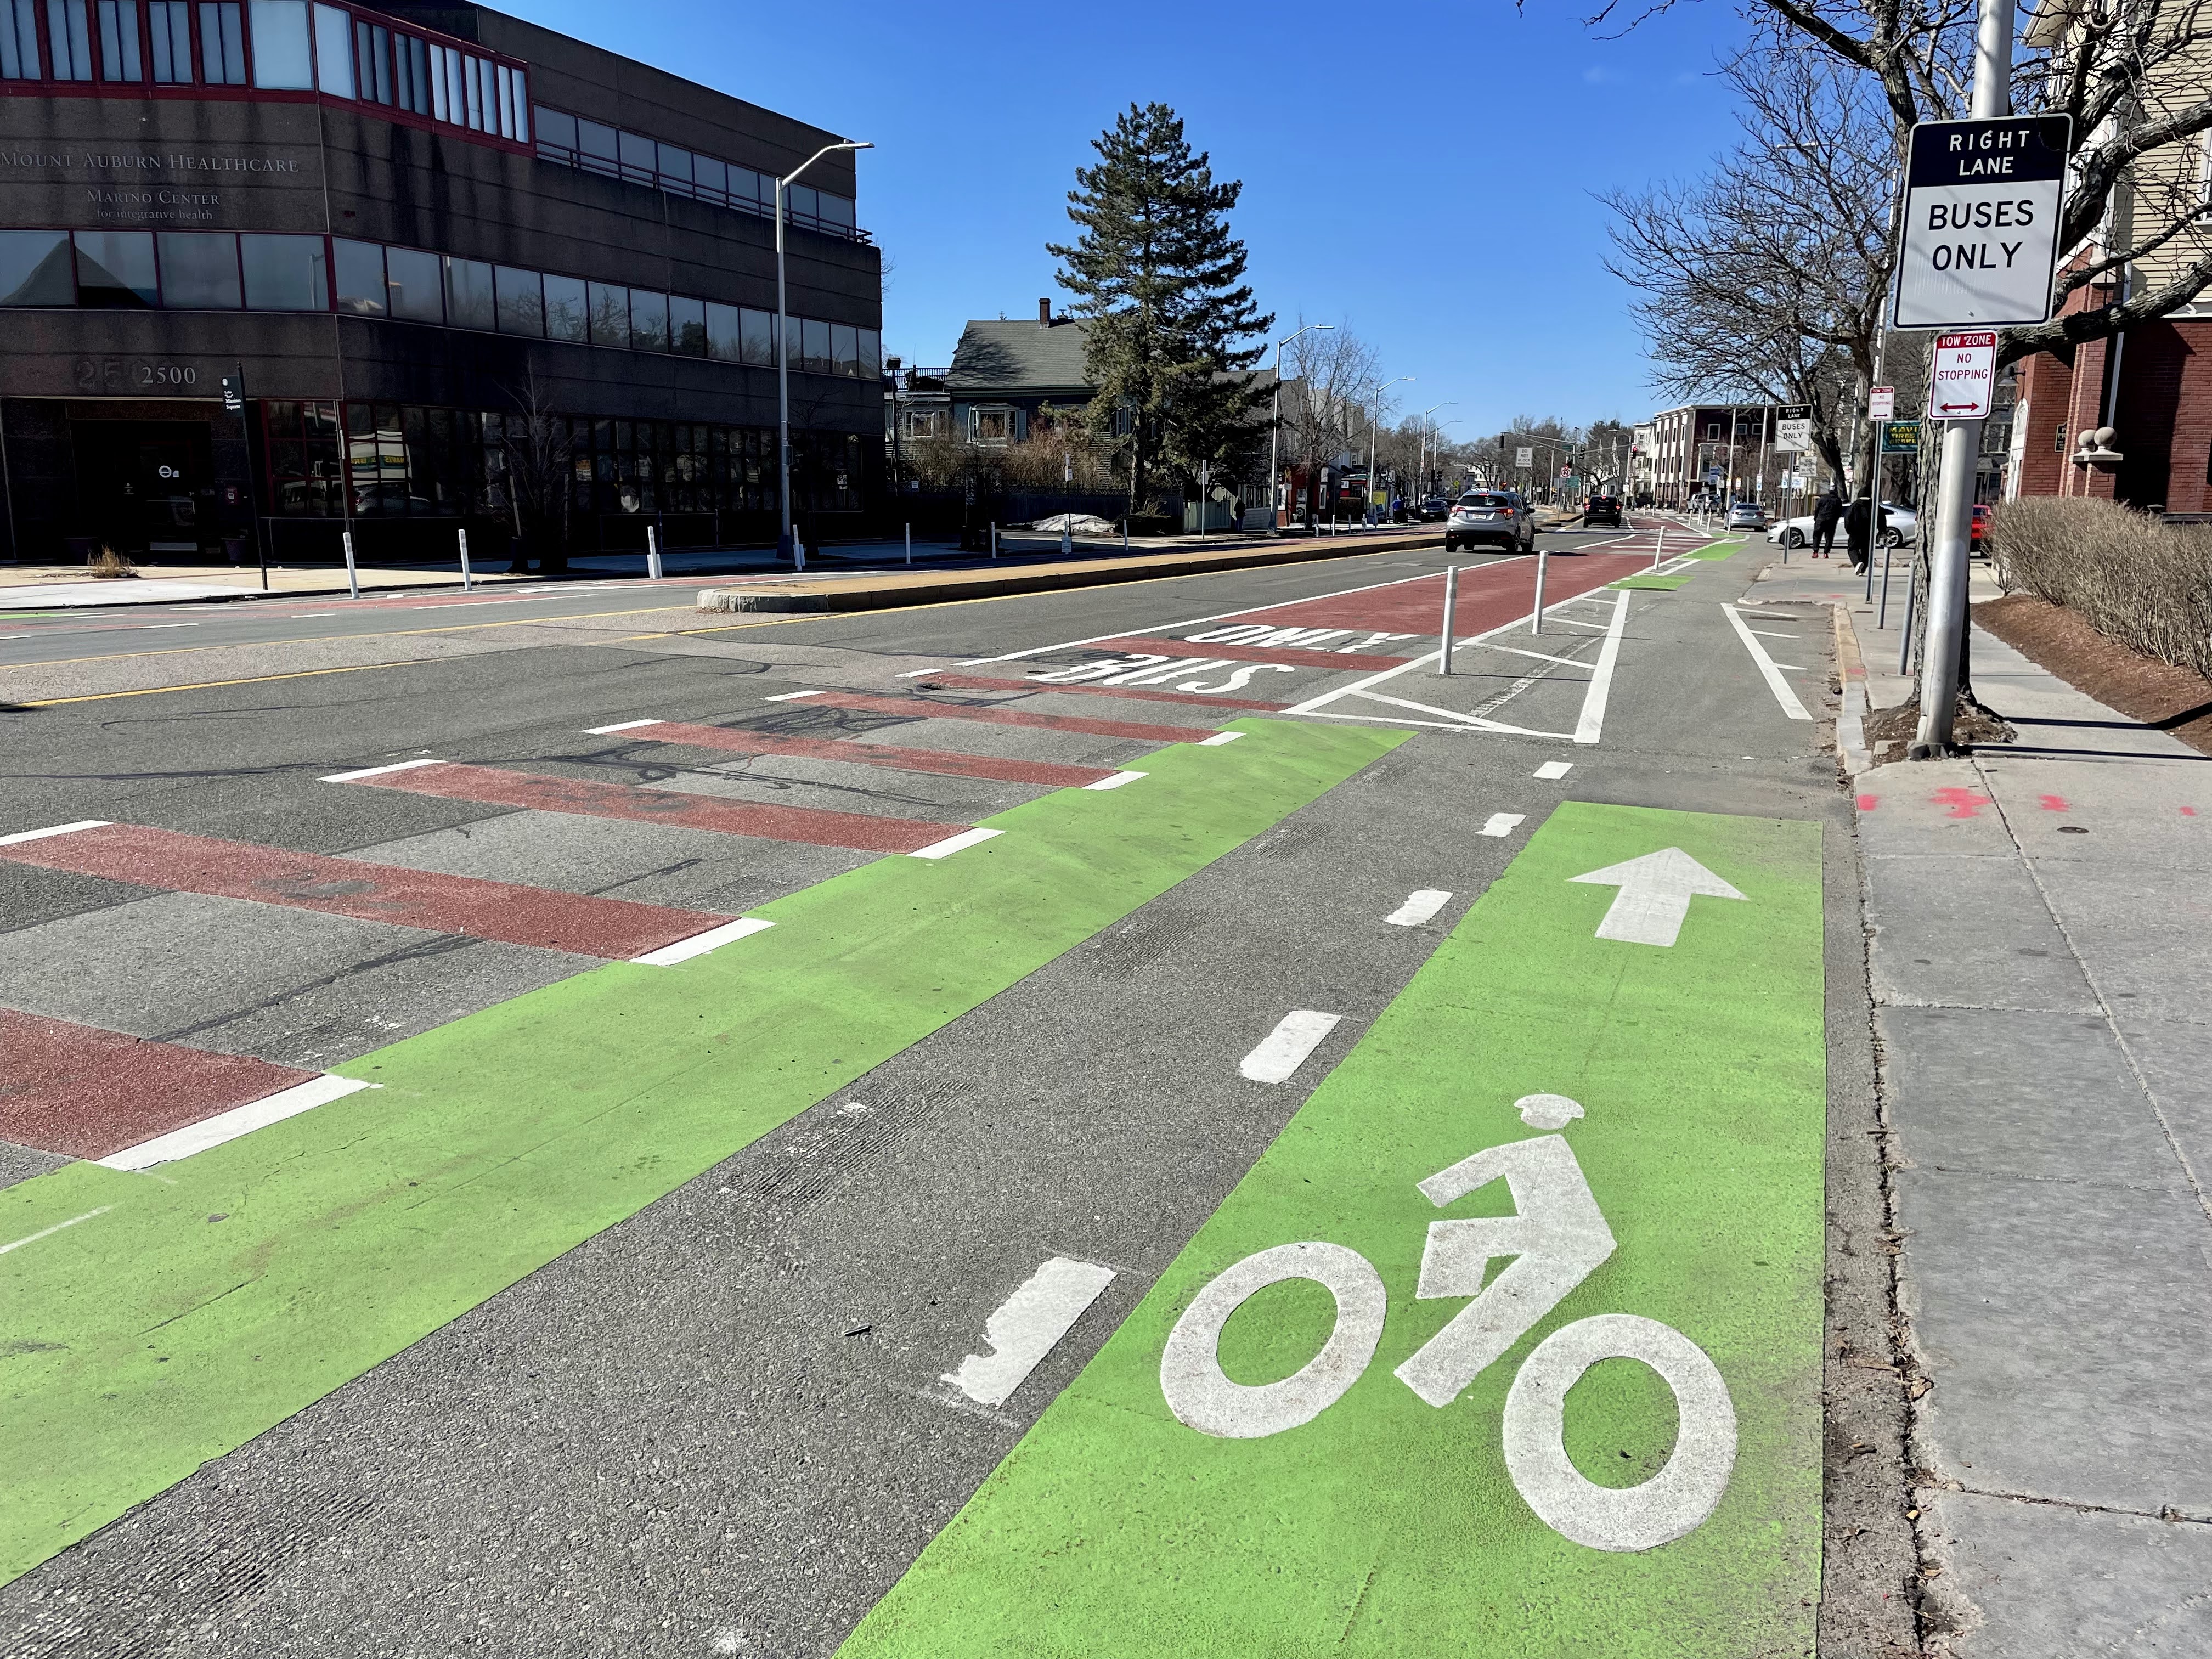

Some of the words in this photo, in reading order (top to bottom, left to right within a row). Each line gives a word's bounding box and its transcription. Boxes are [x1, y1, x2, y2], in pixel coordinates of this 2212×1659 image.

[1949, 129, 2030, 151] RIGHT
[1, 152, 73, 167] MOUNT
[83, 153, 160, 168] AUBURN
[169, 155, 299, 172] HEALTHCARE
[1959, 156, 2013, 176] LANE
[87, 189, 152, 203] MARINO
[159, 190, 219, 205] CENTER
[97, 208, 112, 218] for
[116, 208, 175, 221] integrative
[179, 209, 212, 219] health
[1928, 200, 2034, 230] BUSES
[1932, 241, 2023, 271] ONLY
[1942, 336, 1961, 347] TOW
[1965, 335, 1992, 346] ZONE
[1957, 353, 1972, 363] NO
[141, 366, 196, 384] 2500
[1938, 369, 1988, 381] STOPPING
[1183, 624, 1421, 654] ONLY
[1023, 653, 1295, 695] BUS
